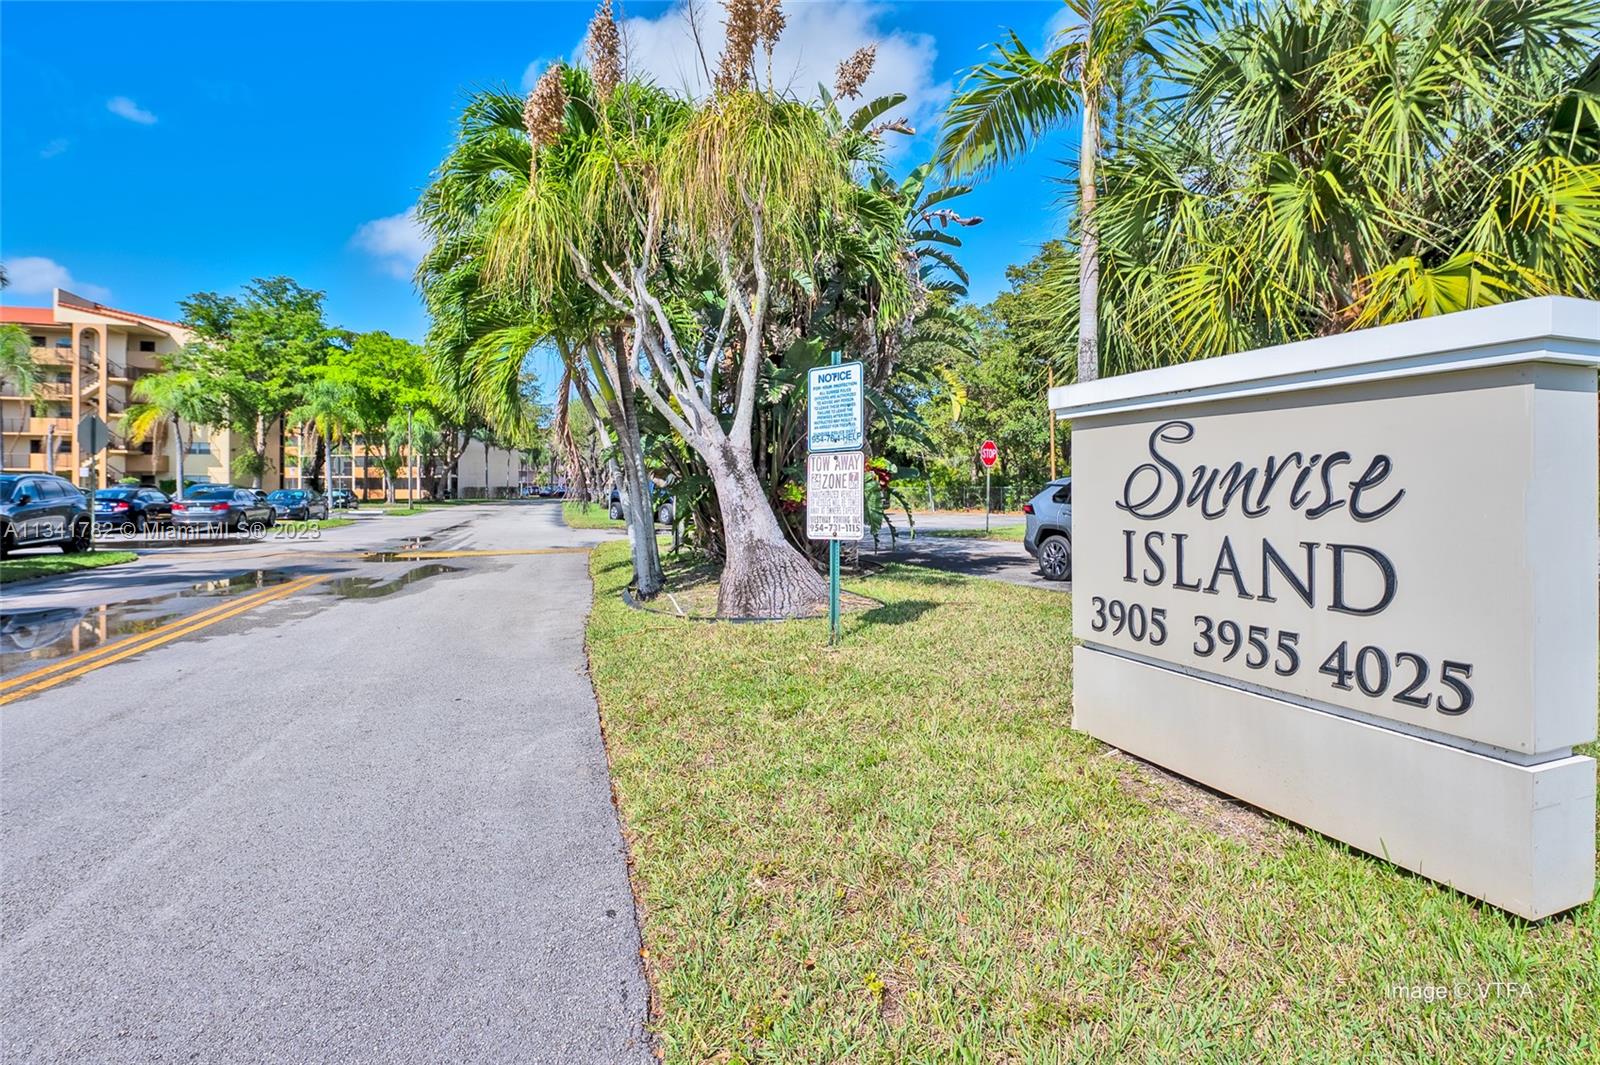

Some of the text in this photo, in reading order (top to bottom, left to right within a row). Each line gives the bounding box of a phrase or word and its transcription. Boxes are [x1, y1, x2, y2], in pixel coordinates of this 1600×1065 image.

[818, 371, 852, 383] NOTICE
[982, 448, 998, 458] STOP
[812, 455, 860, 472] TOW AWAY
[1114, 420, 1406, 524] Sunrise
[822, 473, 847, 489] ZONE
[810, 524, 860, 532] 954-731-1115
[1122, 529, 1398, 618] ISLAND
[1091, 596, 1474, 717] 3905 3955 4025
